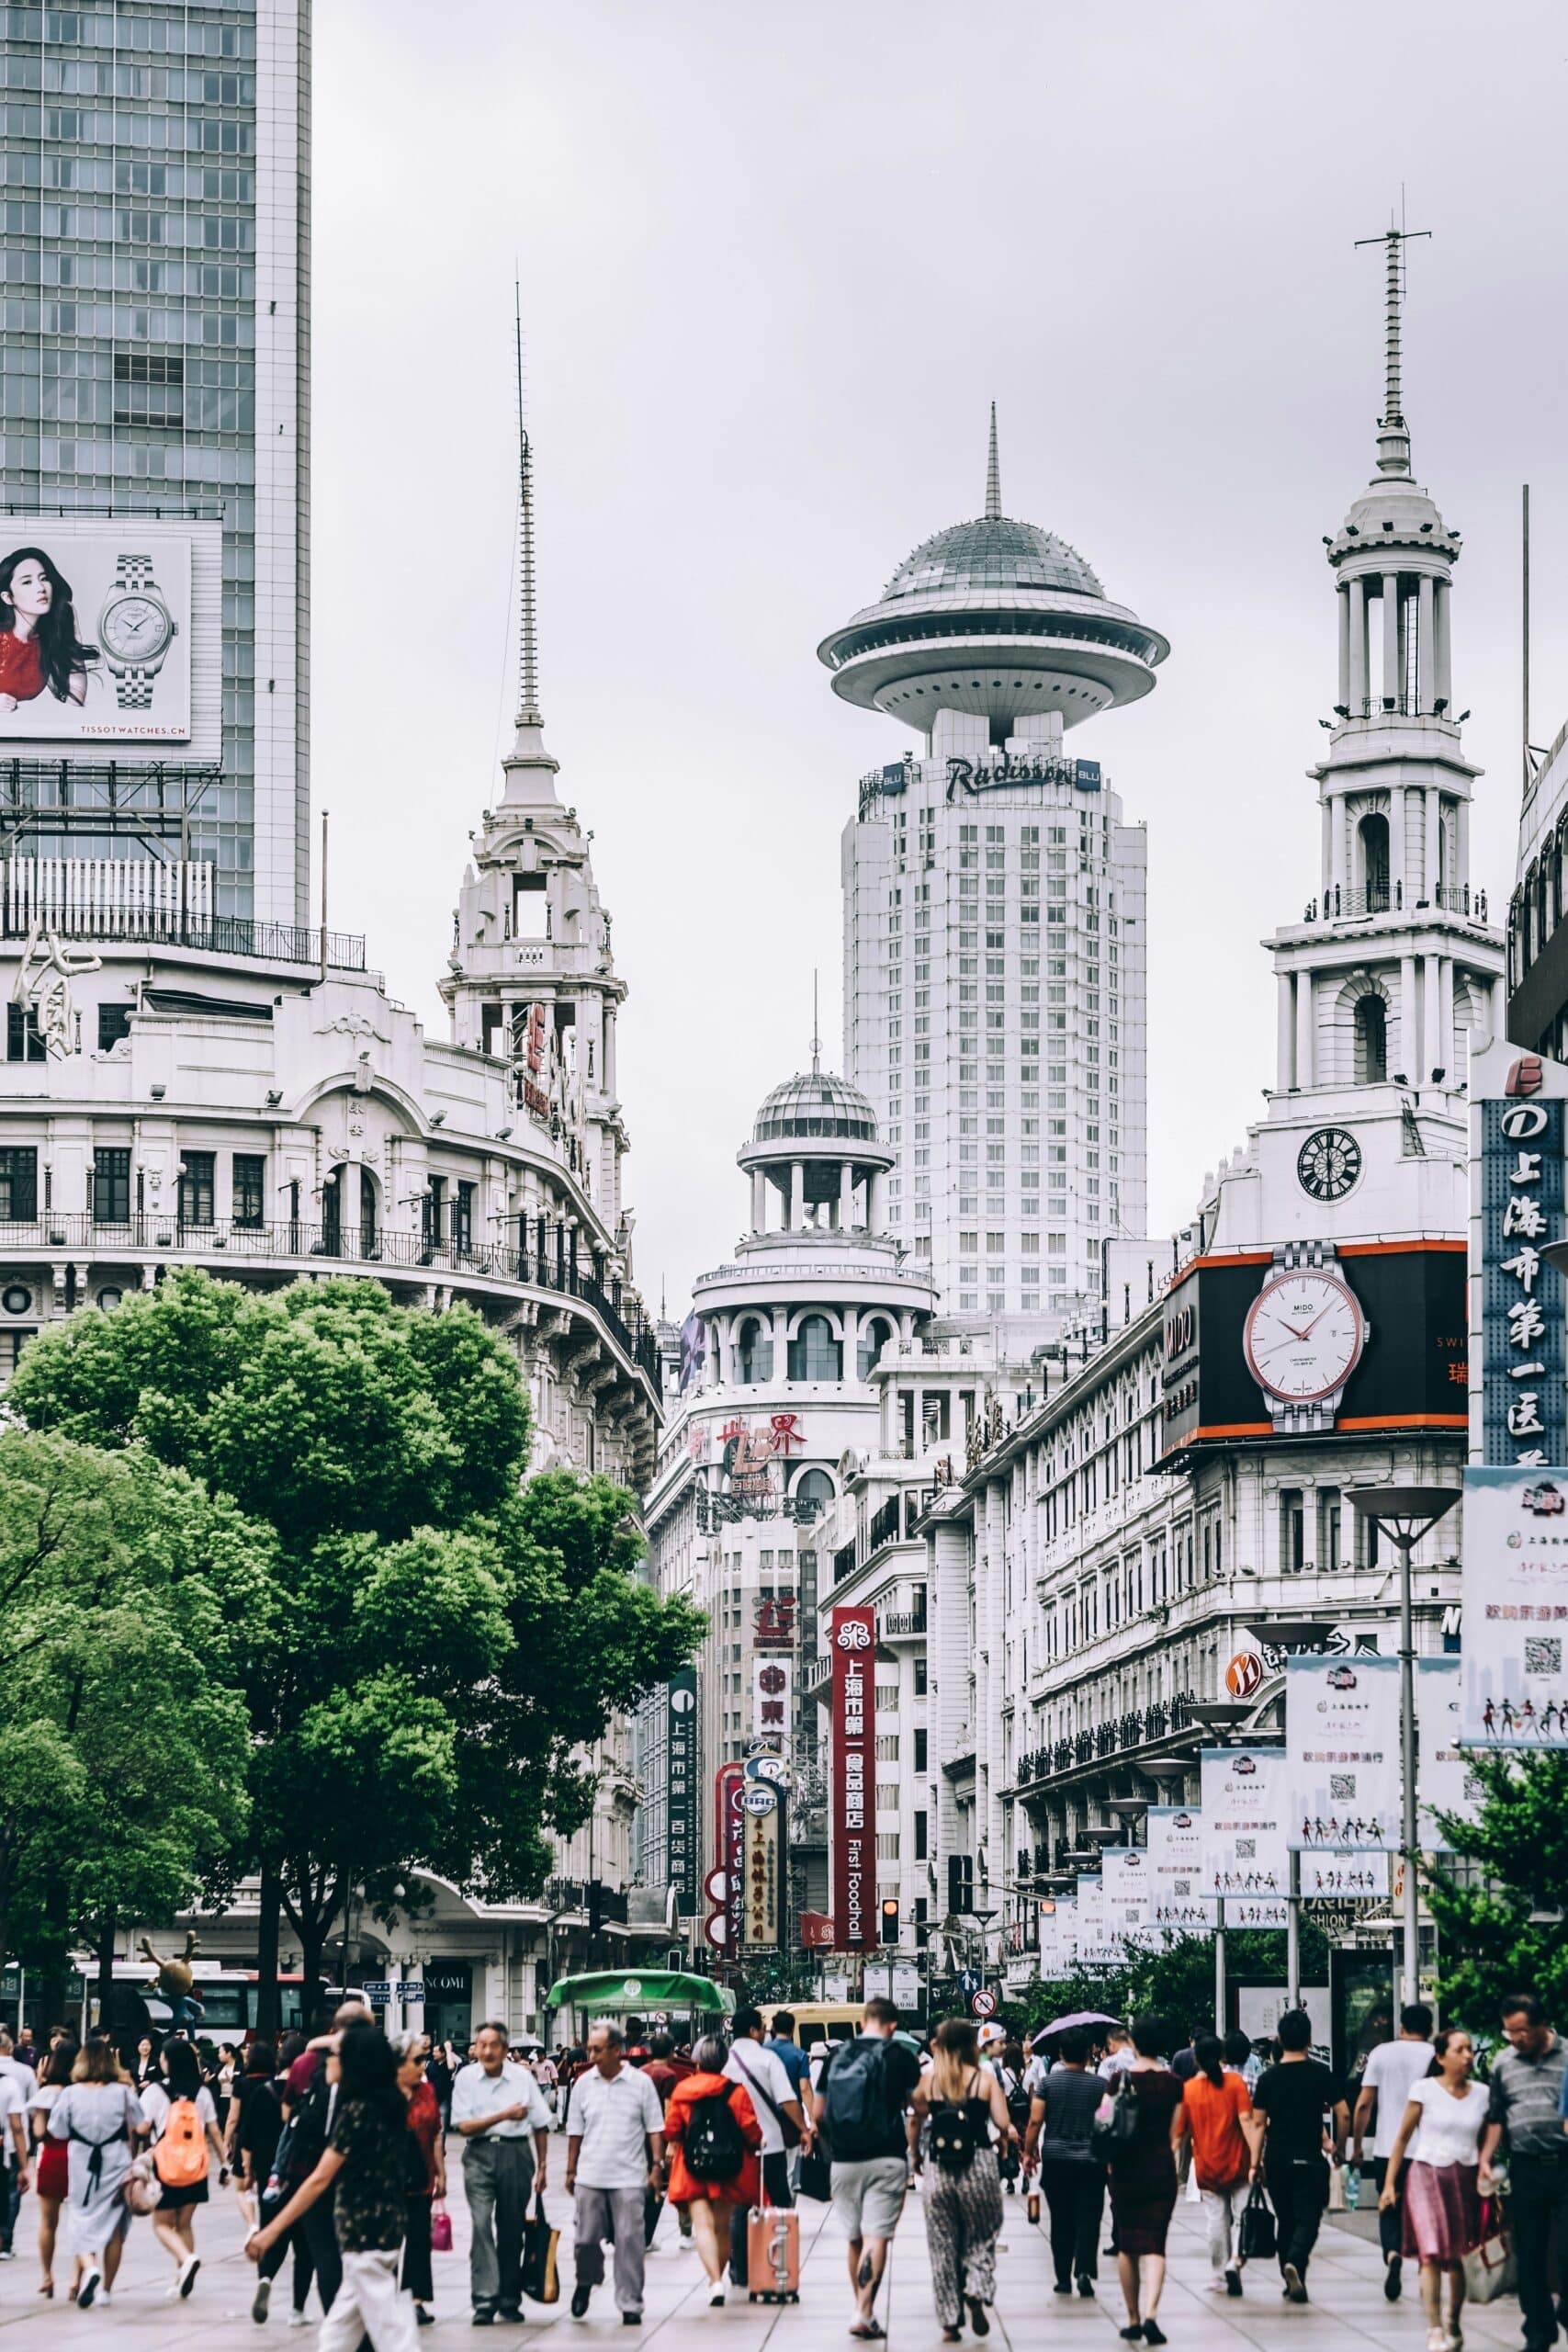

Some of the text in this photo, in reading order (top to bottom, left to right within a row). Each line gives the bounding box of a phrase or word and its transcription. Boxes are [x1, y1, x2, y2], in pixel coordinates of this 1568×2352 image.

[81, 726, 186, 735] TISSOTWATCHES.CN
[884, 774, 902, 786] BLU
[946, 749, 1073, 802] Radisson
[1078, 769, 1100, 782] BLU
[1436, 1338, 1468, 1348] SWI
[1441, 1606, 1461, 1635] N
[844, 1658, 864, 1829] 上海市第一食品商店
[671, 1720, 686, 1894] 上海市第一百货商店
[848, 1839, 863, 1939] First Foodhall
[1309, 1914, 1347, 1928] SHION
